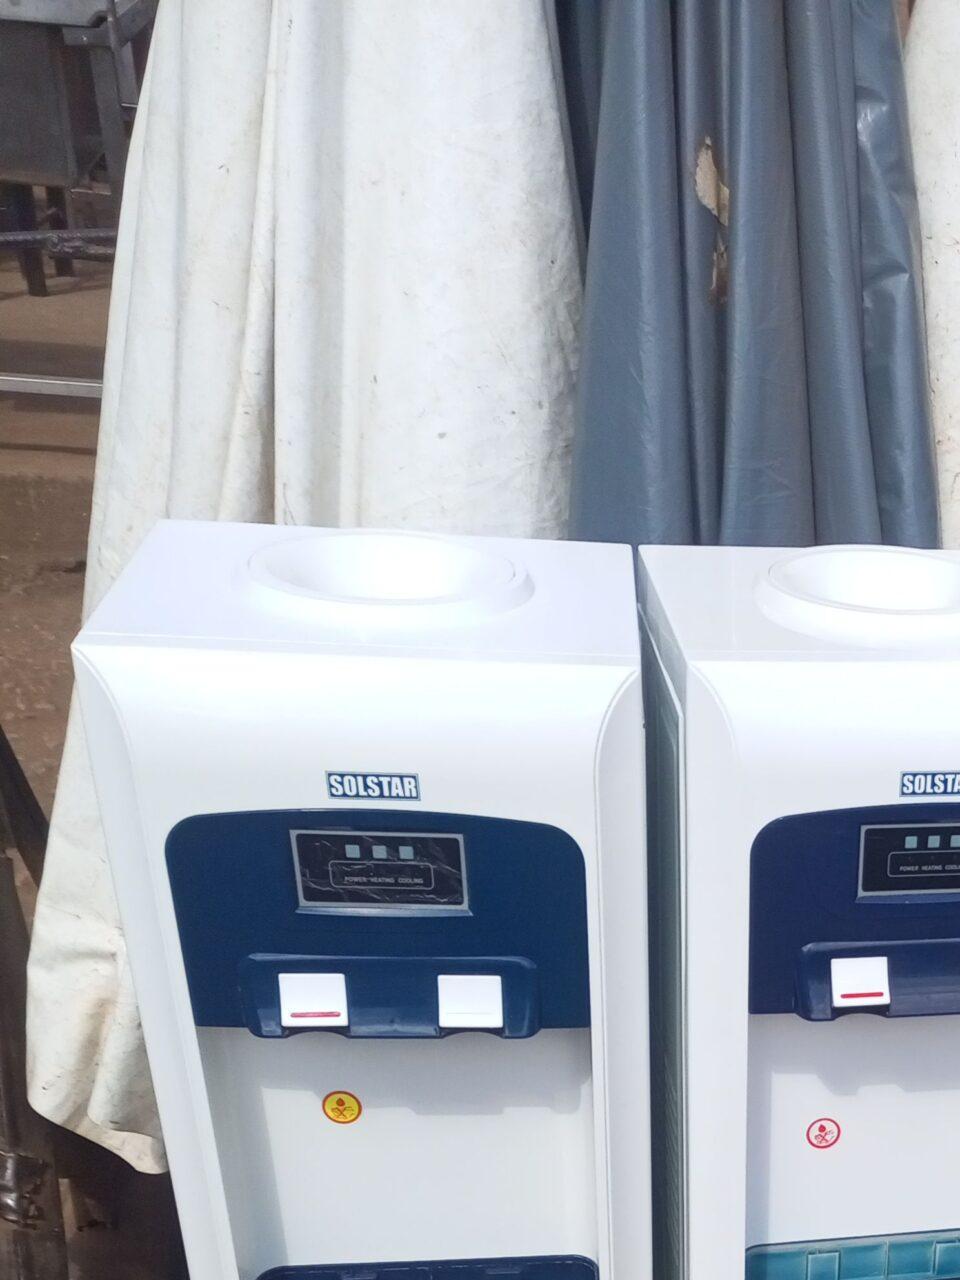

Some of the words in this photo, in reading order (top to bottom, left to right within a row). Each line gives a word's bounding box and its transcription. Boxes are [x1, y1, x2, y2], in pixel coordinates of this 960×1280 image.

[328, 774, 418, 798] SOLSTAR
[921, 864, 943, 872] HEATING
[398, 877, 424, 885] COOLING
